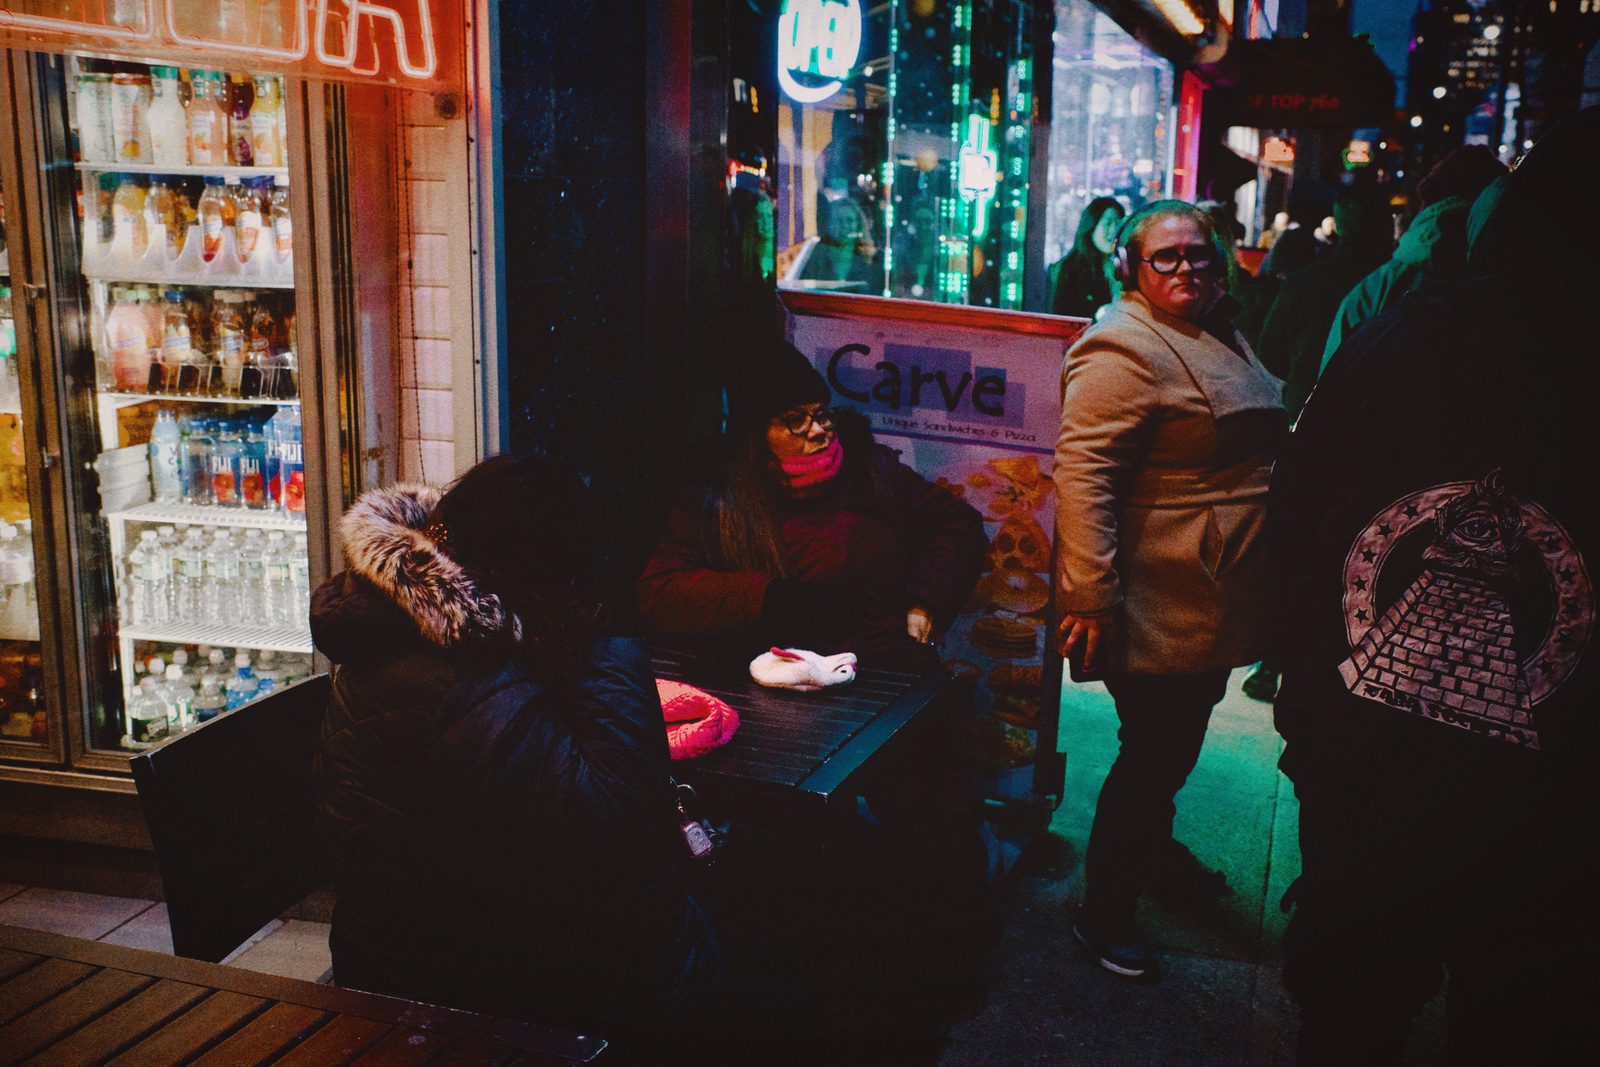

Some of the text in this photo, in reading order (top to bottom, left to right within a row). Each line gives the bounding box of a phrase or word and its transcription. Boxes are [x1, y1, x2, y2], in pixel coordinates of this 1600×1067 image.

[827, 343, 1007, 418] Carve
[882, 415, 919, 431] Unique
[923, 420, 986, 438] Sandwiches
[1004, 429, 1037, 443] Pizza
[280, 443, 303, 462] FIJI
